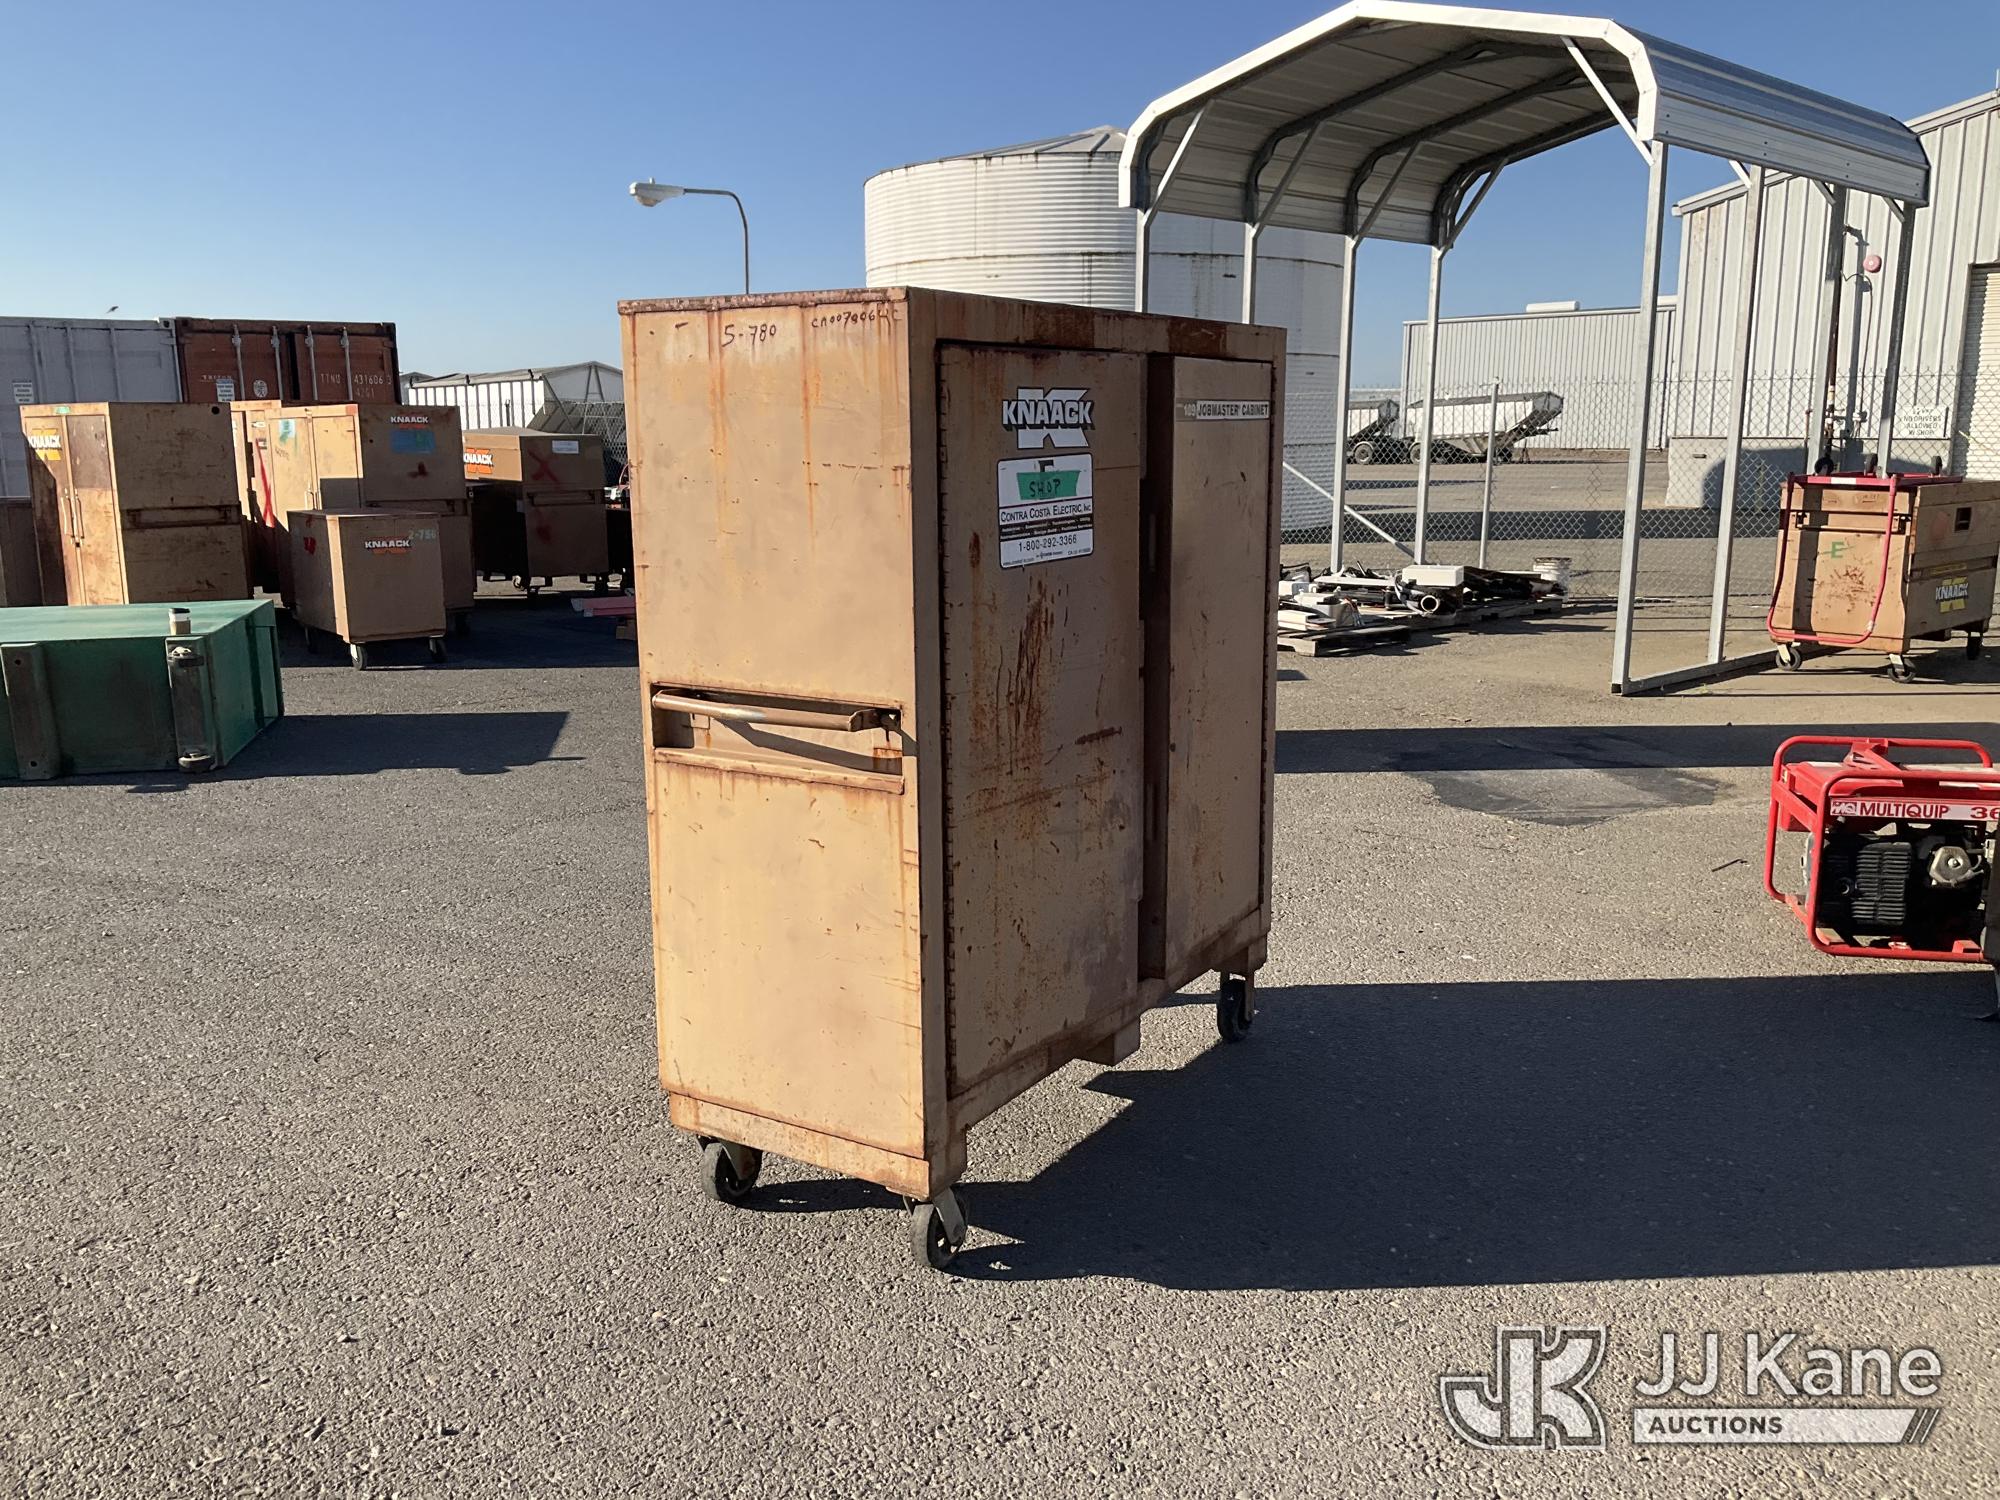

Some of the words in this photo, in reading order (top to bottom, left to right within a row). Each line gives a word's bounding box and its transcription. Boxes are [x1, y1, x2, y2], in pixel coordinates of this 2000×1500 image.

[354, 374, 384, 385] 431606
[1002, 399, 1094, 427] KNAACK
[1198, 404, 1240, 417] JOBMASTER
[1241, 403, 1269, 416] CABINET
[390, 415, 430, 424] KNAACK
[1029, 478, 1061, 498] SHOP
[1001, 510, 1029, 523] CONTRA
[1029, 507, 1051, 519] COSTA
[364, 538, 411, 549] KNAACK
[1935, 582, 1969, 601] KNAACK
[1859, 802, 1950, 819] MULTIQUIP
